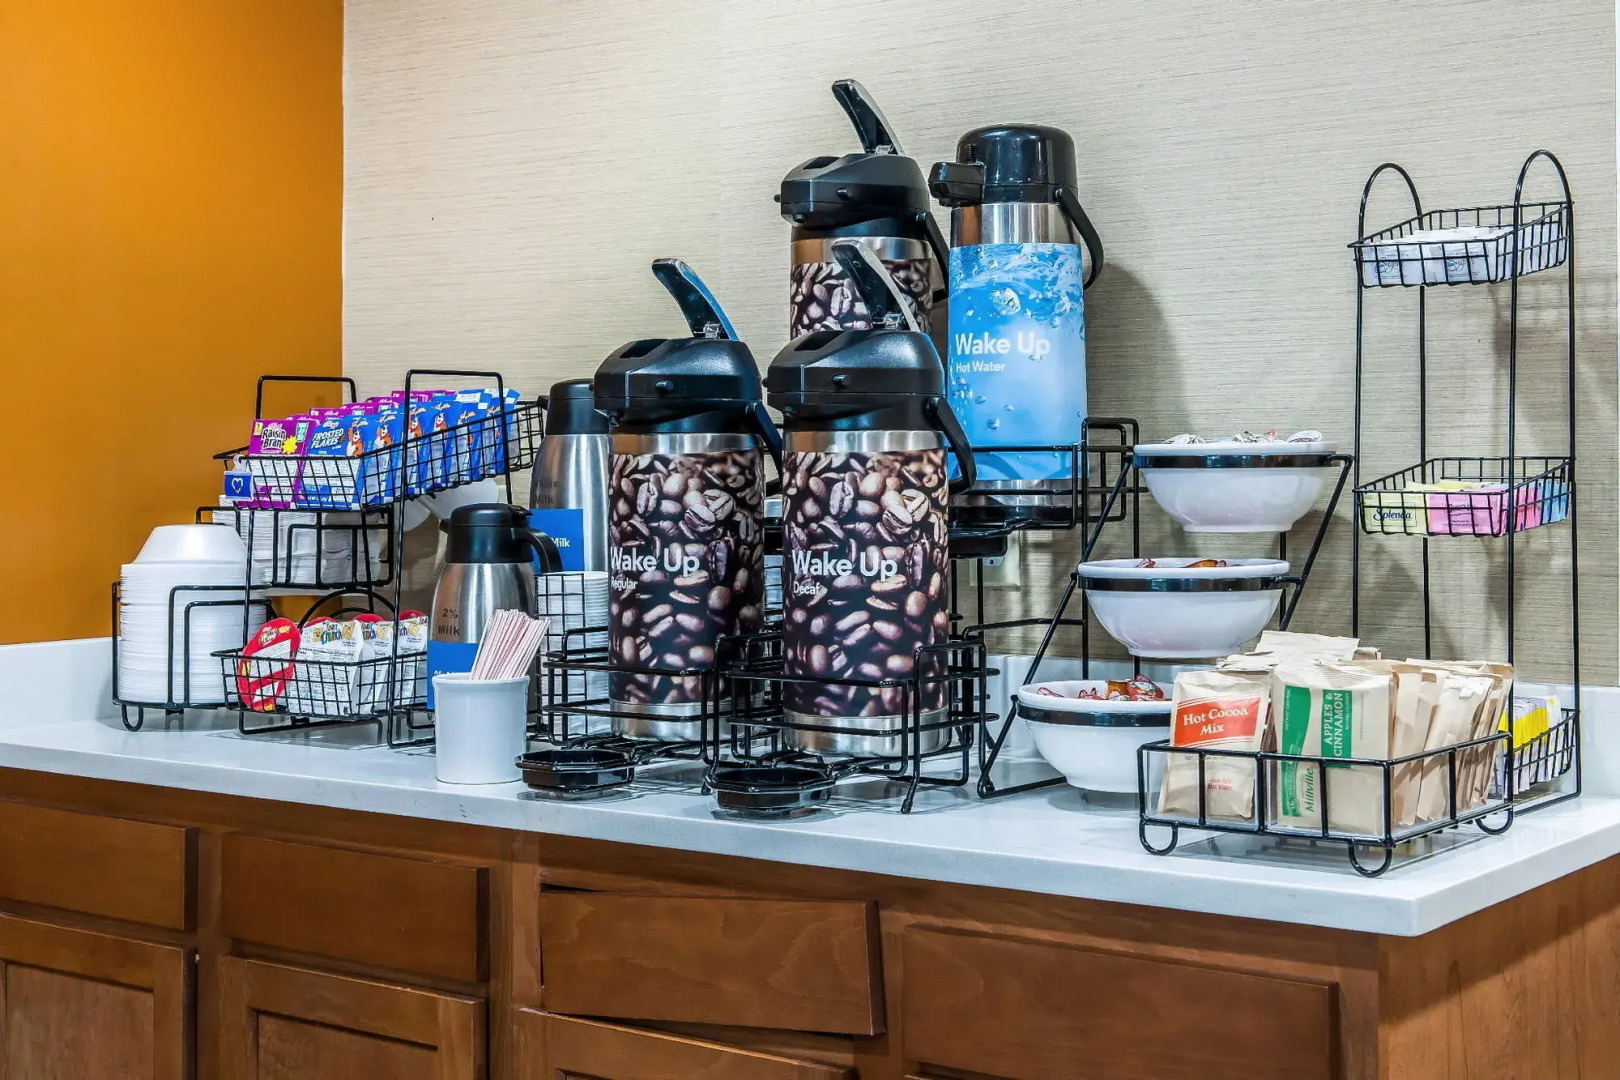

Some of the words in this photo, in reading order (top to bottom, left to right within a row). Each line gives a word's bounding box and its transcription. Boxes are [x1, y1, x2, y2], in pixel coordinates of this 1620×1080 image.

[955, 331, 1011, 356] Wake
[1017, 331, 1052, 360] Up
[956, 362, 970, 373] Hot
[972, 360, 1006, 372] Water
[262, 428, 286, 440] Raisin
[313, 428, 344, 441] FROSTED
[263, 439, 282, 449] Bran
[311, 437, 340, 449] FLAKES
[551, 537, 570, 547] Milk
[610, 546, 657, 572] Wake
[663, 547, 700, 577] Up
[792, 549, 853, 576] Wake
[860, 551, 898, 582] Up
[610, 576, 638, 591] Regular
[793, 580, 820, 595] Decaf
[442, 608, 458, 619] 2%
[437, 624, 460, 636] Milk
[1325, 692, 1333, 700] &
[1183, 712, 1207, 726] Hot
[1208, 707, 1249, 720] Cocoa
[1200, 723, 1225, 735] Mix
[1324, 703, 1333, 745] APPLES
[1333, 692, 1343, 757] CINNAMON
[1303, 768, 1315, 813] Millville
